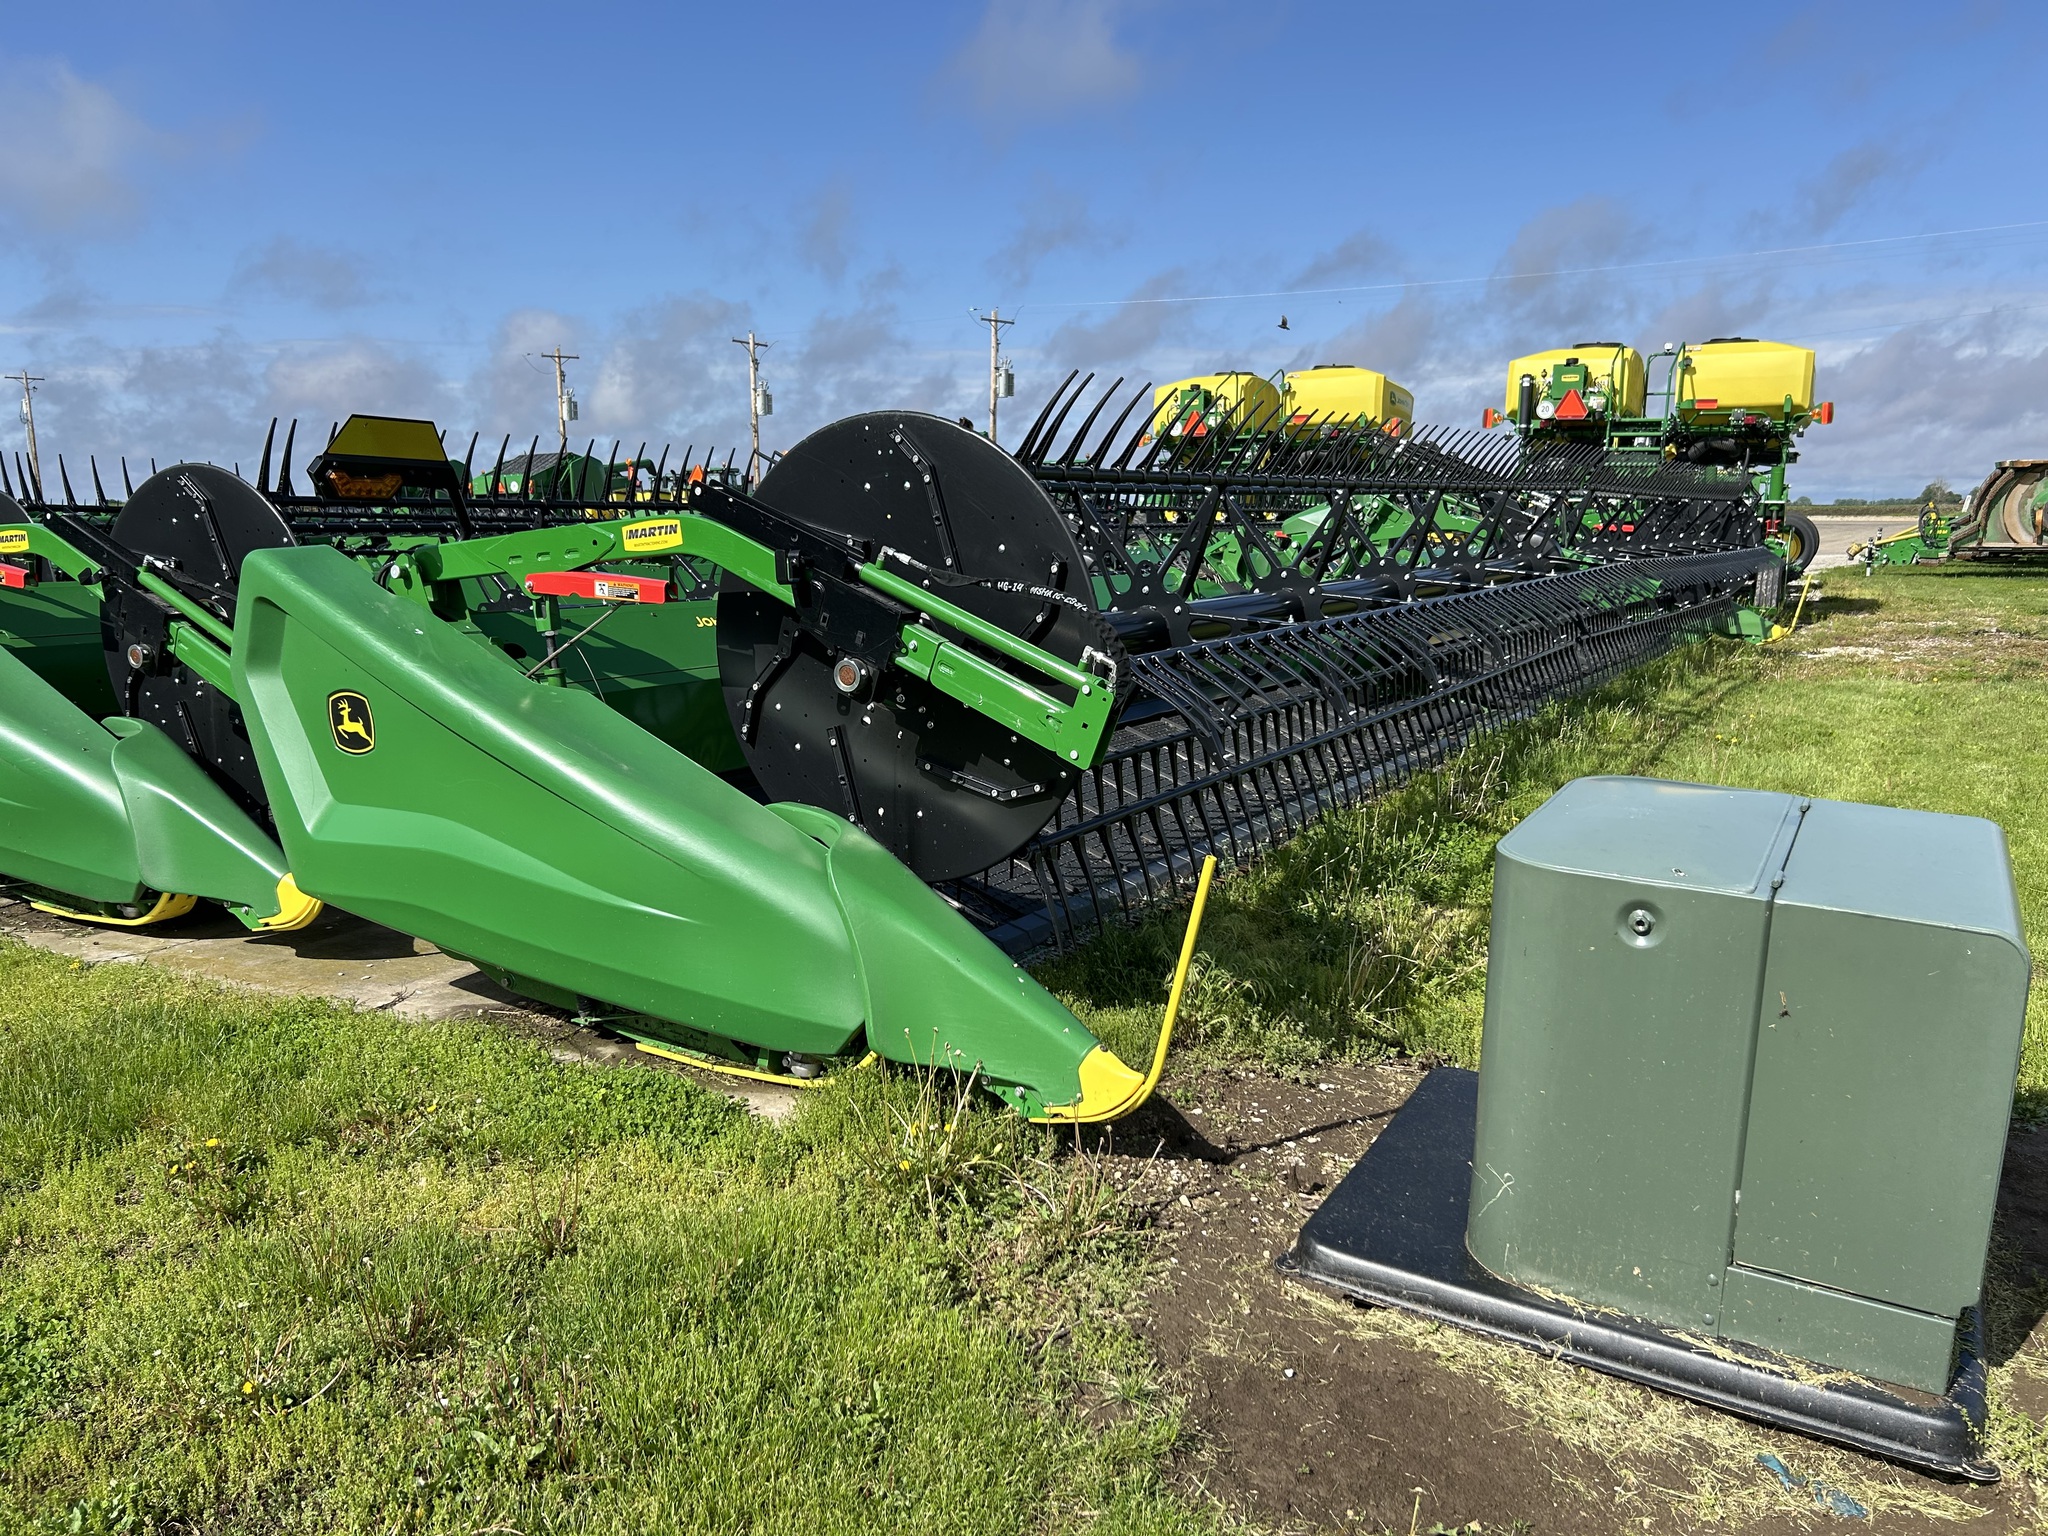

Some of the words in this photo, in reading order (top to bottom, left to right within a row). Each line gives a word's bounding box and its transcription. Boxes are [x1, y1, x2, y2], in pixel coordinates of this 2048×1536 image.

[1541, 405, 1550, 413] 20
[628, 524, 678, 539] MARTIN
[0, 533, 26, 543] MARTIN
